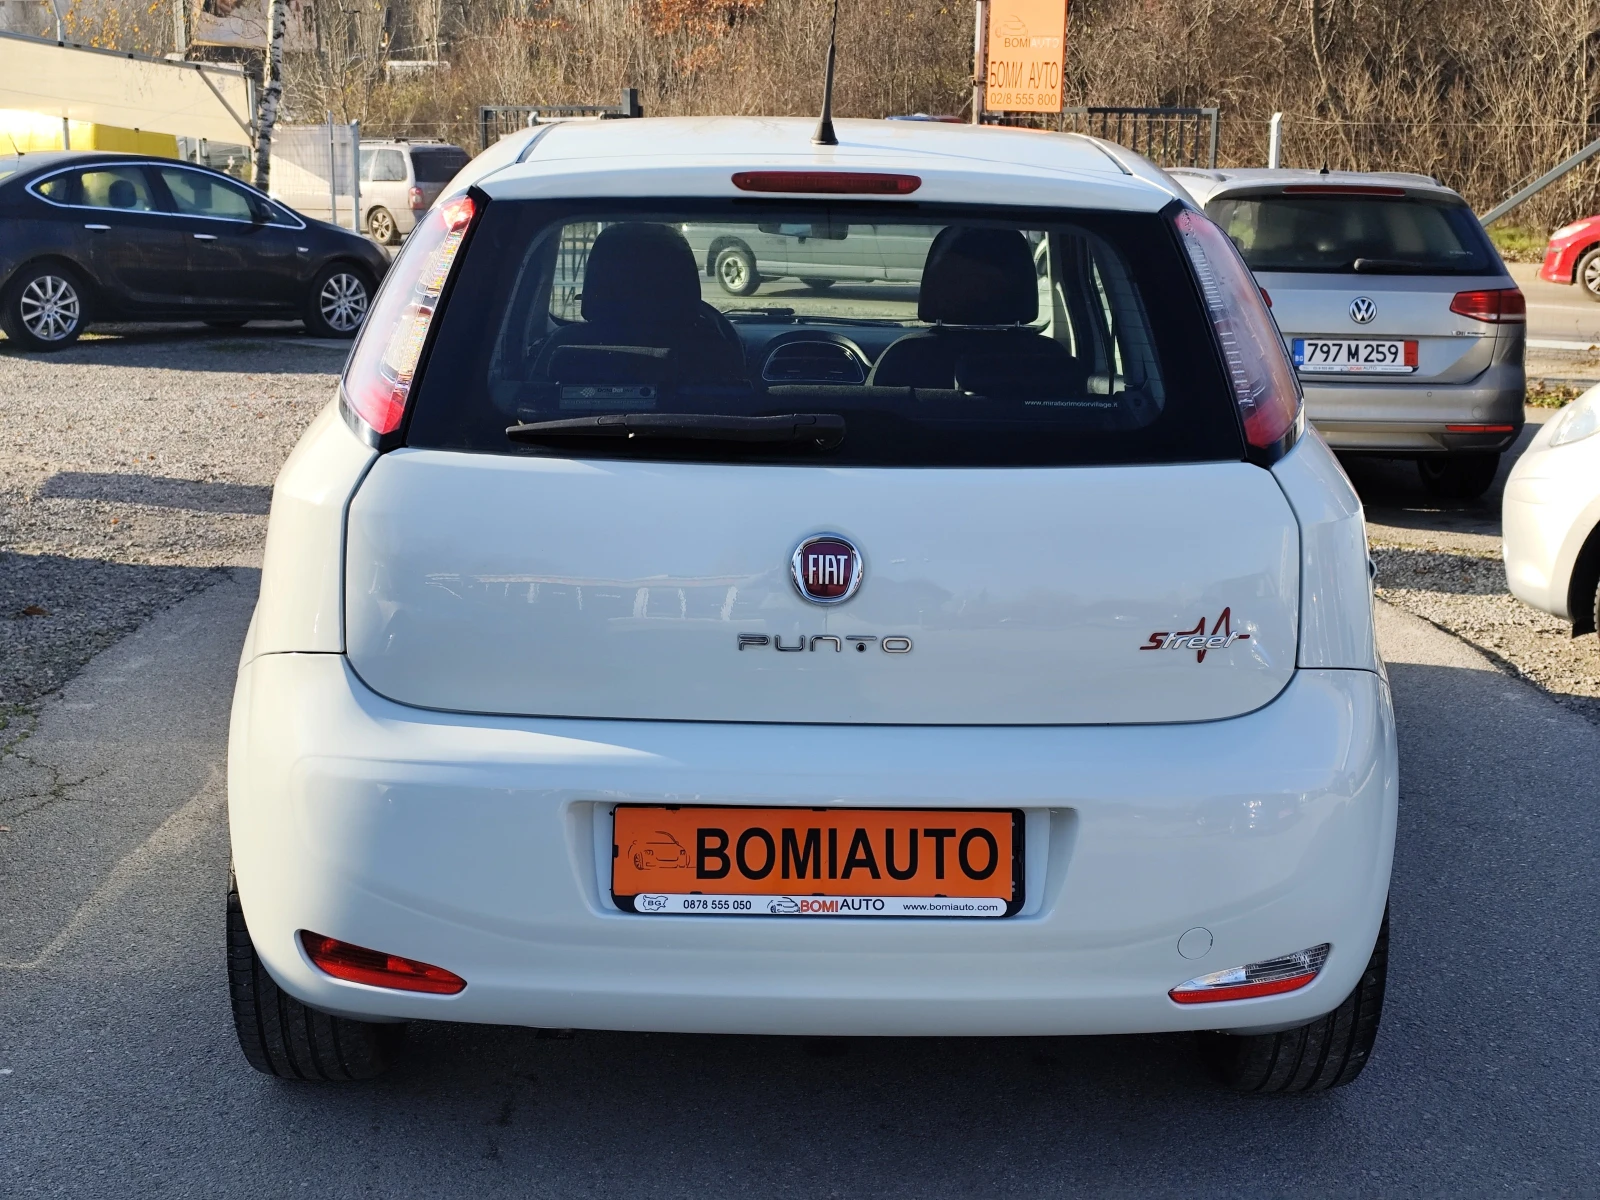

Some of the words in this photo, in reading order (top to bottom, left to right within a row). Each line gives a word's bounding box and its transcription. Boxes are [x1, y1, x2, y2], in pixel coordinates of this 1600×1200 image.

[1004, 38, 1060, 48] BOMIAUTO
[990, 61, 1023, 88] БОМИ
[1028, 61, 1059, 89] АУТО
[990, 93, 1012, 105] 02/8
[1015, 94, 1034, 105] 555
[1037, 94, 1057, 106] 800
[1307, 343, 1343, 362] 797
[1347, 344, 1359, 362] M
[1363, 344, 1399, 363] 259
[808, 555, 848, 585] FIAT
[737, 633, 912, 653] PUNTO
[696, 827, 999, 881] BOMIAUTO
[683, 900, 708, 910] 0878
[711, 900, 730, 910] 555
[732, 900, 752, 910] 050
[903, 903, 998, 912] www.bomiauto.com
